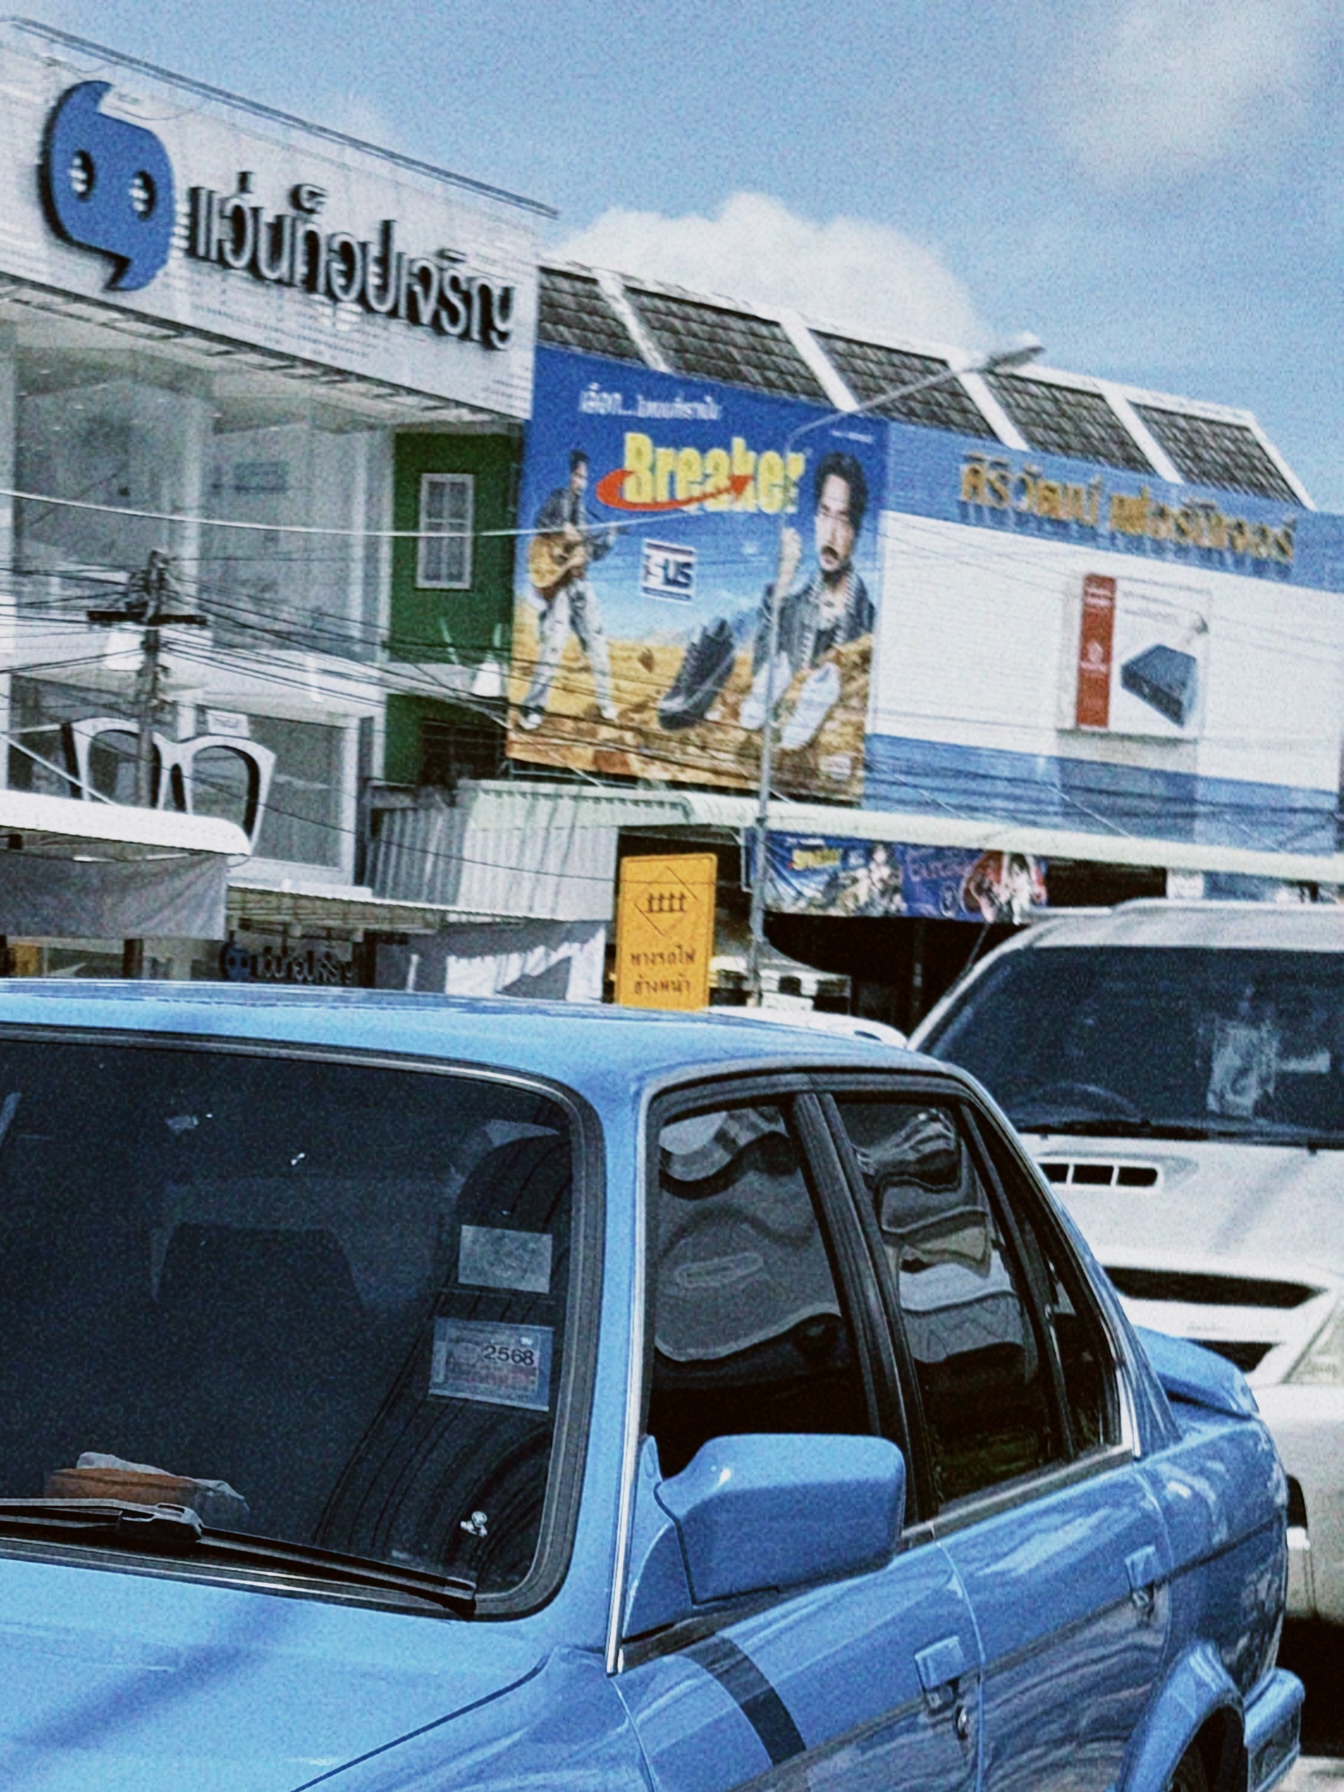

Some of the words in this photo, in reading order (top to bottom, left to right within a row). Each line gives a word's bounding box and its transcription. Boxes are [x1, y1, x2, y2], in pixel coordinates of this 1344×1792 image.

[186, 170, 515, 350] แว่นท็อปเจริญ
[623, 431, 806, 515] Breaker
[630, 944, 696, 967] ทางรถไฟ
[633, 973, 692, 995] ข้างหน้า
[482, 1344, 536, 1368] 2568
